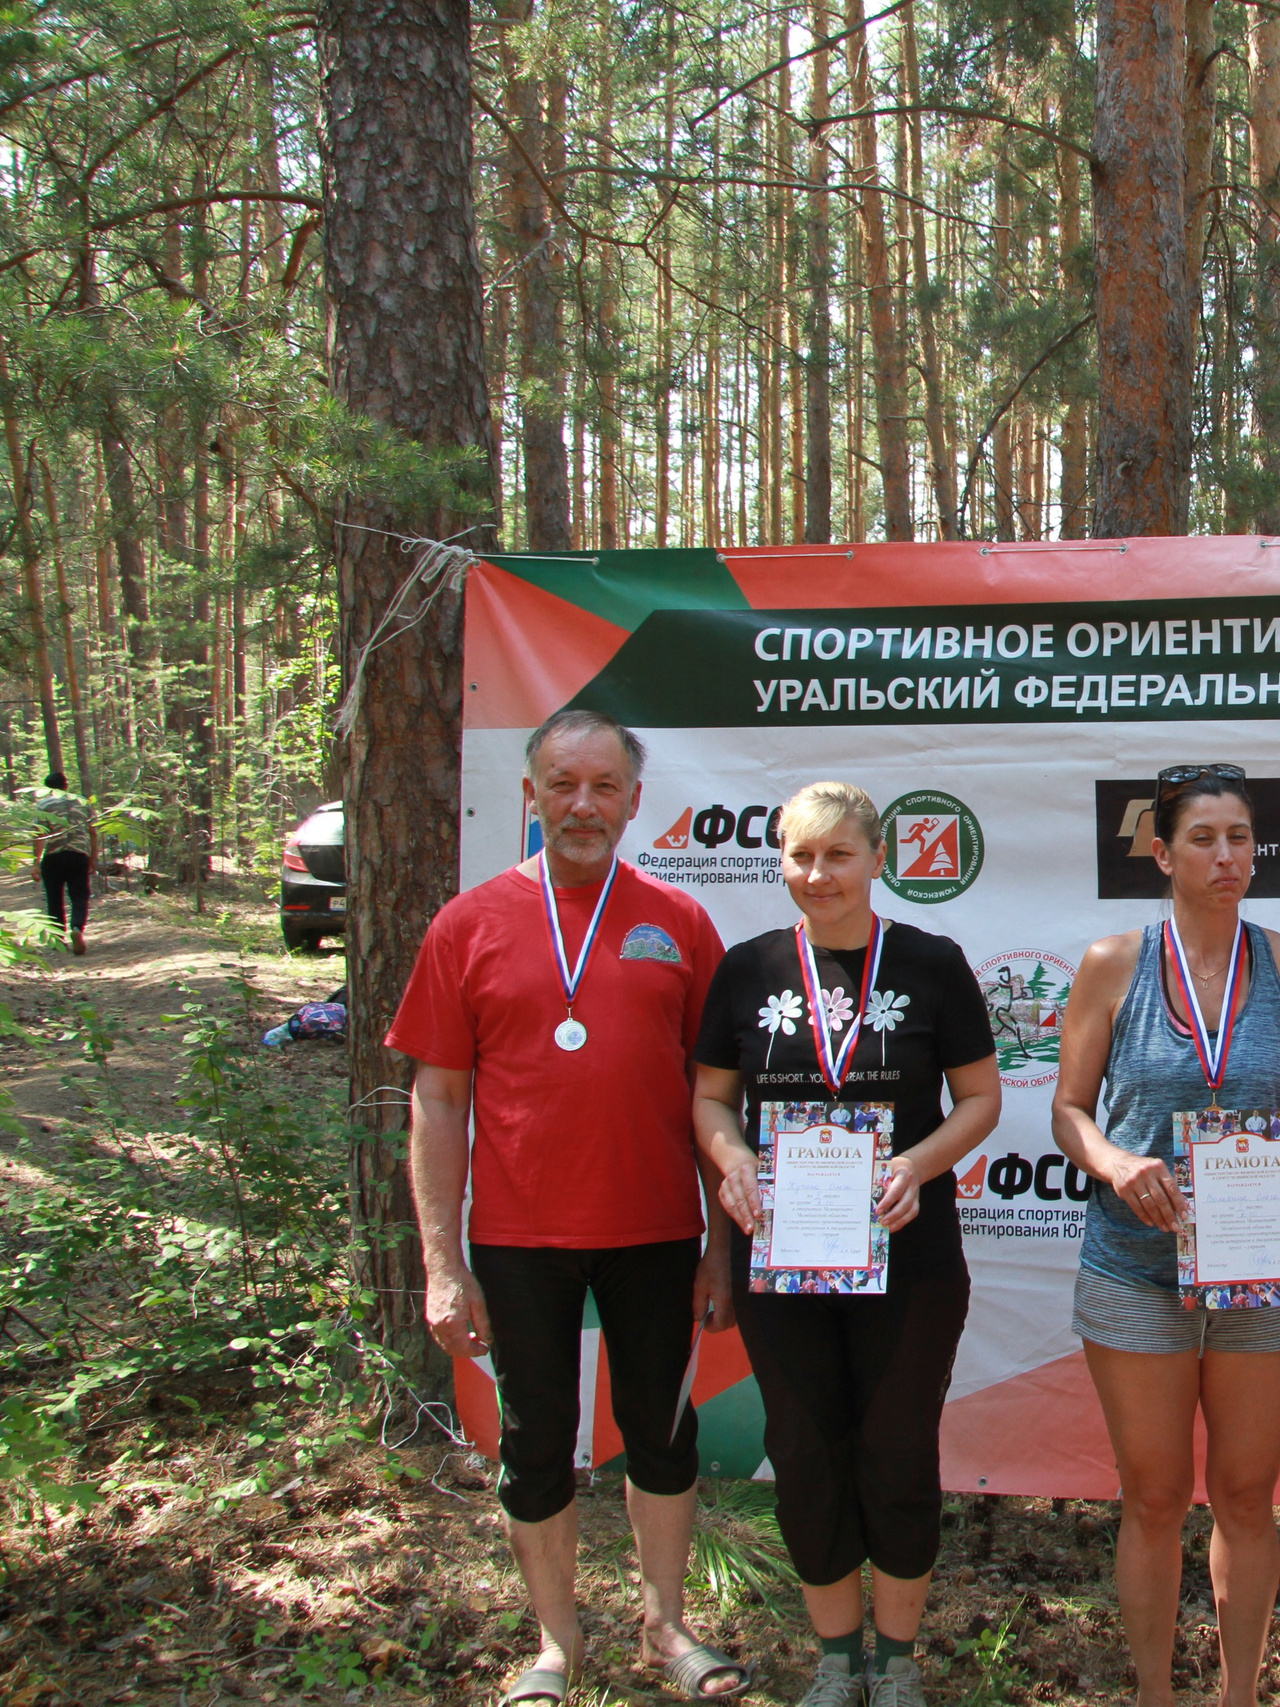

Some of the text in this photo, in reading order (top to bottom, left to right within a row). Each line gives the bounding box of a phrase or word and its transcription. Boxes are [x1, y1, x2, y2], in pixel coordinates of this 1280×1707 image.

[754, 624, 1054, 661] СПОРТИВНОЕ
[753, 668, 1000, 712] УРАЛЬСКИЙ
[906, 795, 961, 813] СПОРТИВНОГО
[962, 815, 980, 886] ОРИЕНТИРОВАНИЯ
[638, 852, 717, 871] Федерация
[645, 871, 758, 886] риентирования
[883, 861, 957, 899] ТЮМЕНСКОЙ ОБЛАС
[981, 951, 1041, 972] СПОРТИВНОГО
[756, 1074, 769, 1084] LIFE
[867, 1071, 878, 1081] THE
[880, 1070, 900, 1080] RULES
[787, 1147, 863, 1159] ГРАМОТА
